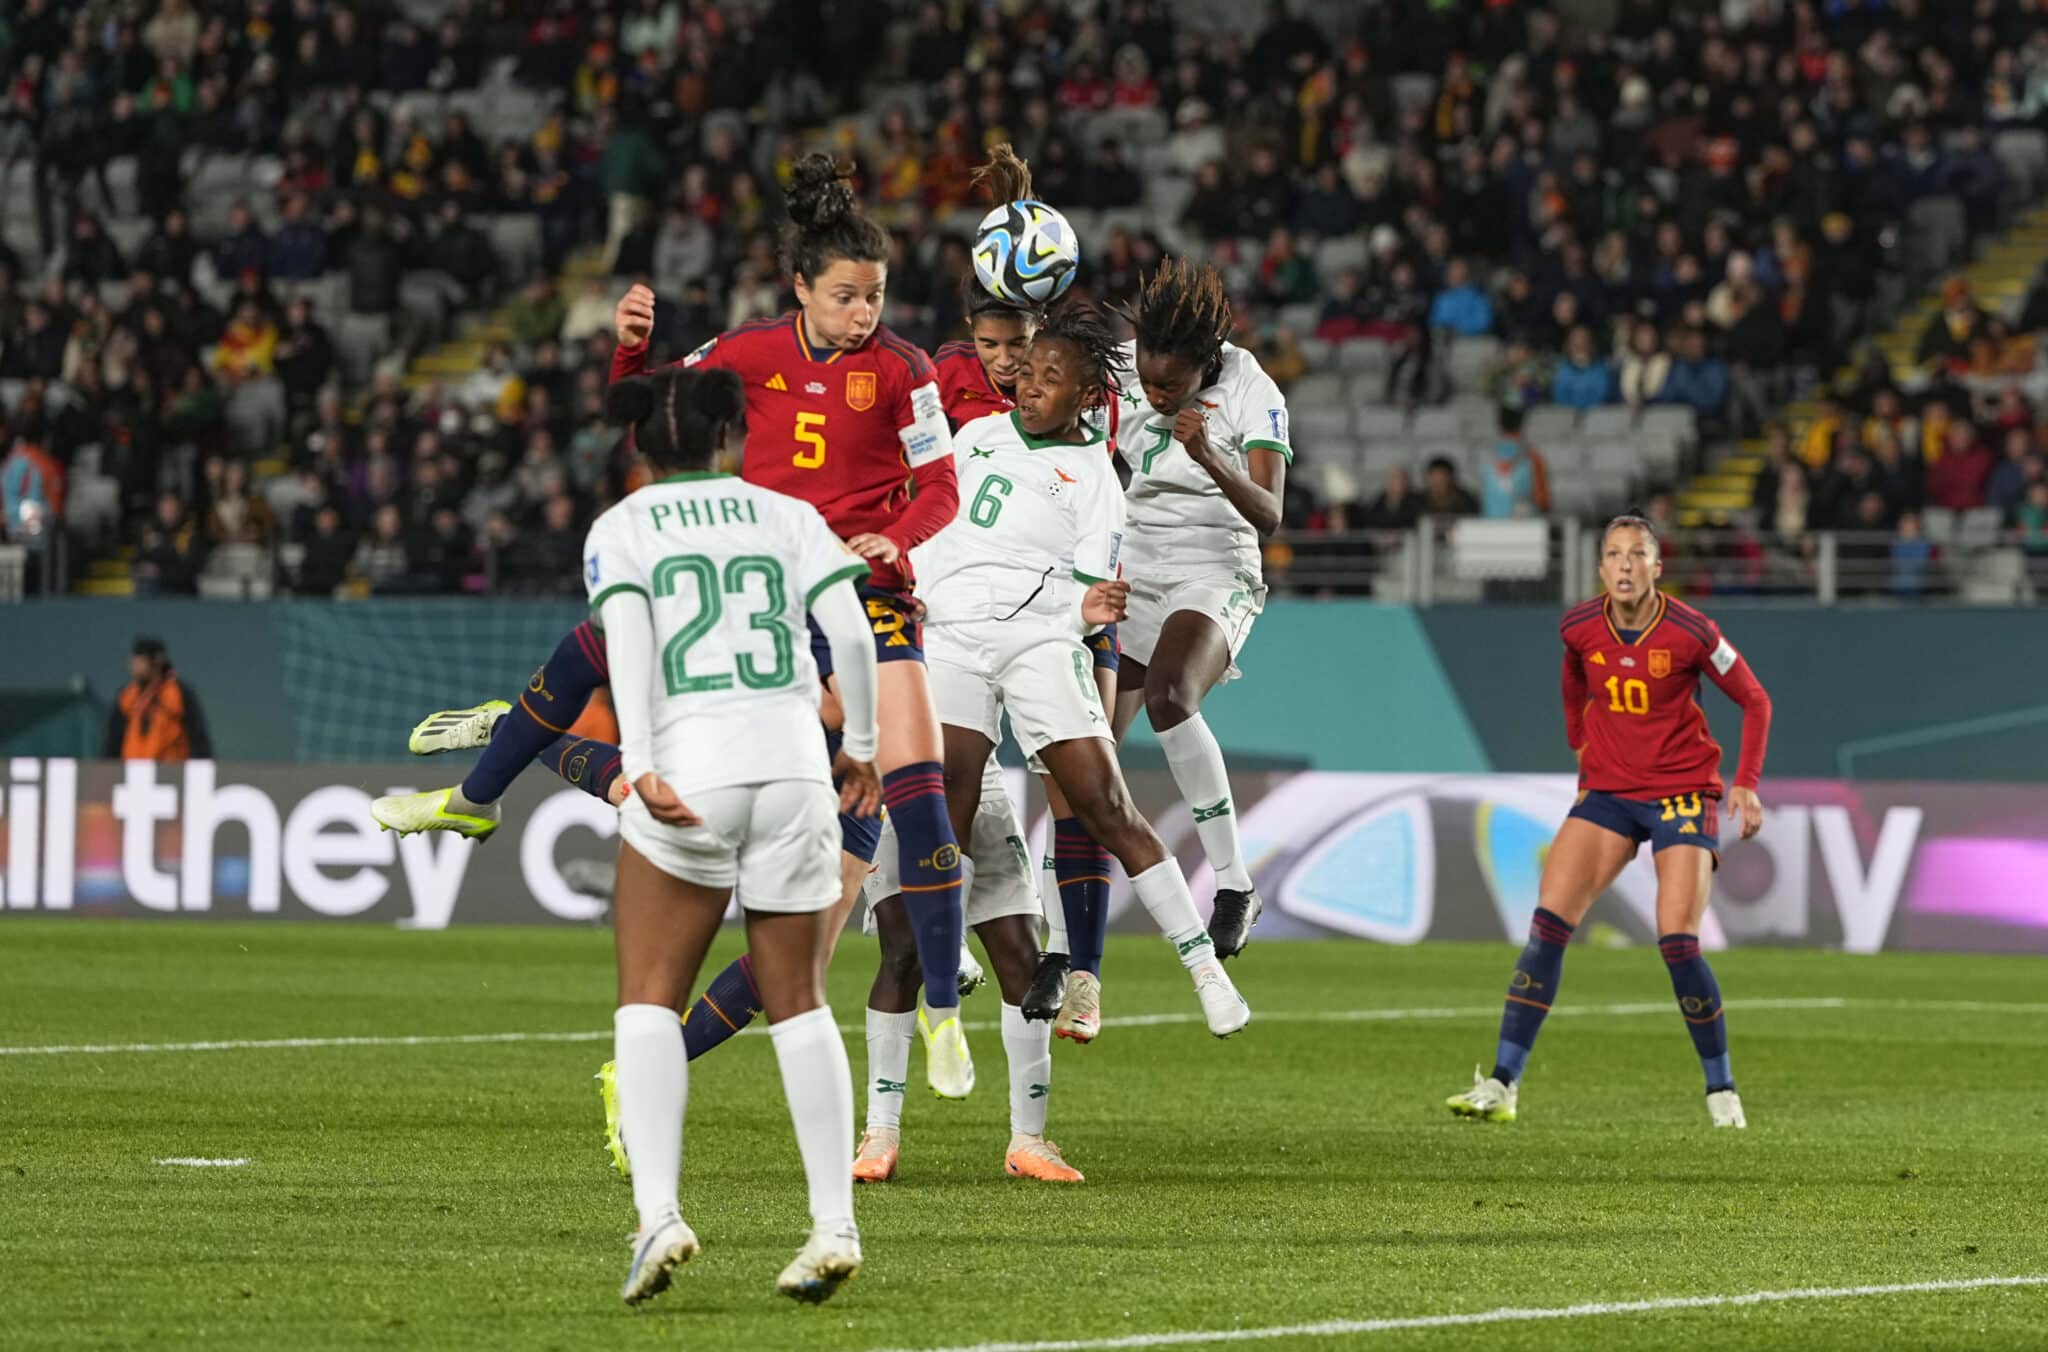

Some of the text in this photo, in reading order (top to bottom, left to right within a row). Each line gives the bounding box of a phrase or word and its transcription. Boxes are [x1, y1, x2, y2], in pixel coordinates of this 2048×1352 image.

[793, 411, 826, 469] 5
[1141, 422, 1172, 475] 7
[649, 496, 759, 532] PHIRI
[969, 473, 1013, 529] 6
[651, 553, 795, 696] 23
[1604, 675, 1649, 715] 10
[0, 757, 77, 909] il
[112, 758, 474, 930] they
